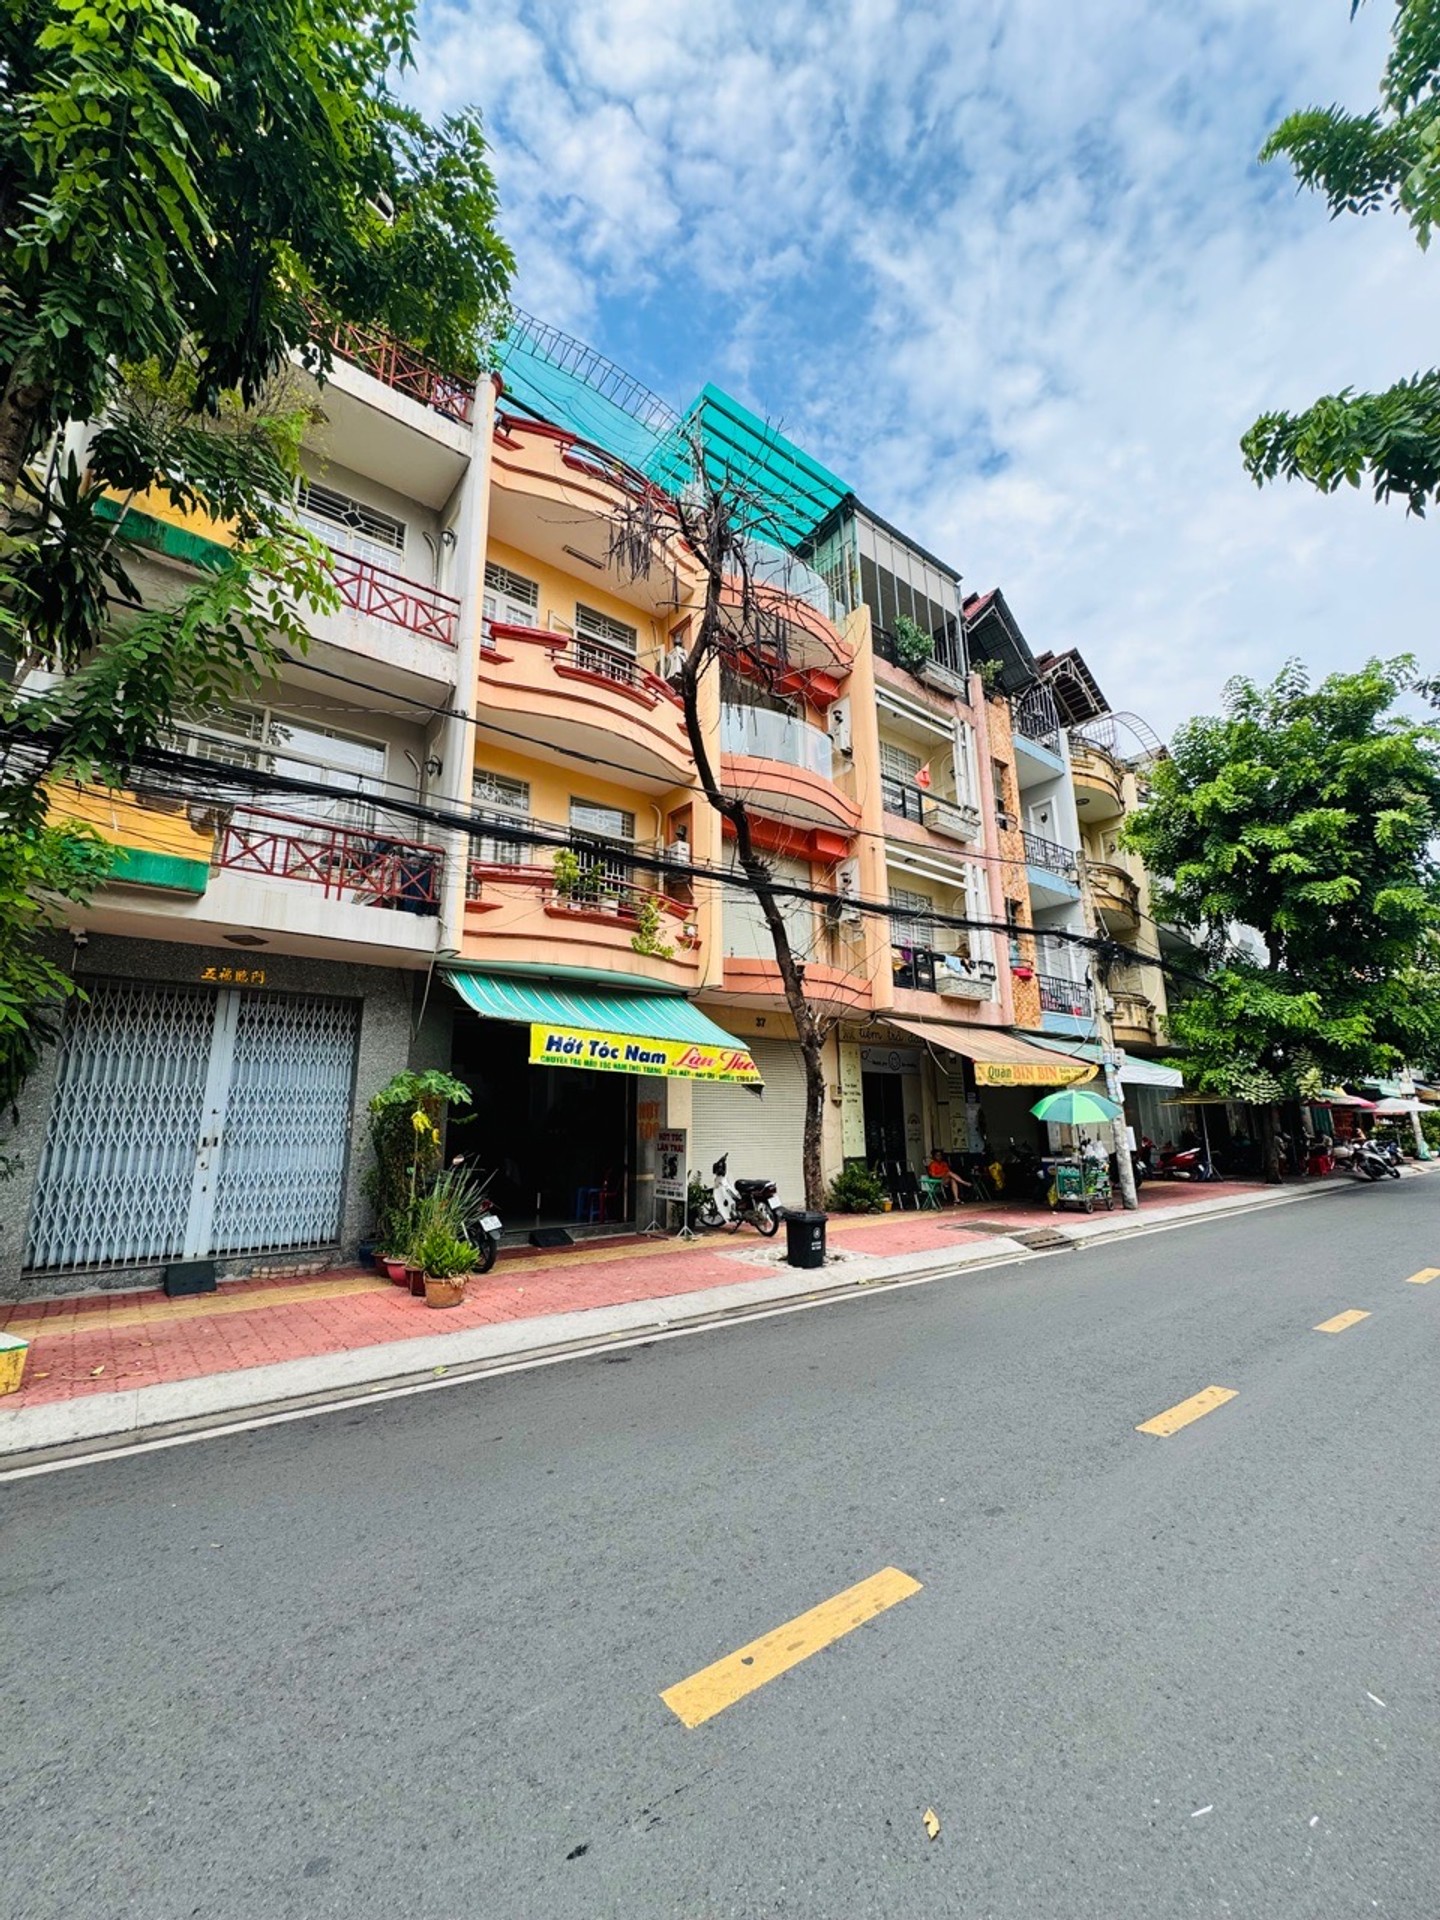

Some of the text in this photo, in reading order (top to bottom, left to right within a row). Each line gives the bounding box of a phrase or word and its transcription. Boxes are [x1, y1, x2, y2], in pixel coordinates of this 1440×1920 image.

[545, 1035, 584, 1055] Hớt
[589, 1040, 620, 1059] Tóc
[624, 1045, 667, 1064] Nam
[987, 1065, 1012, 1080] Quán
